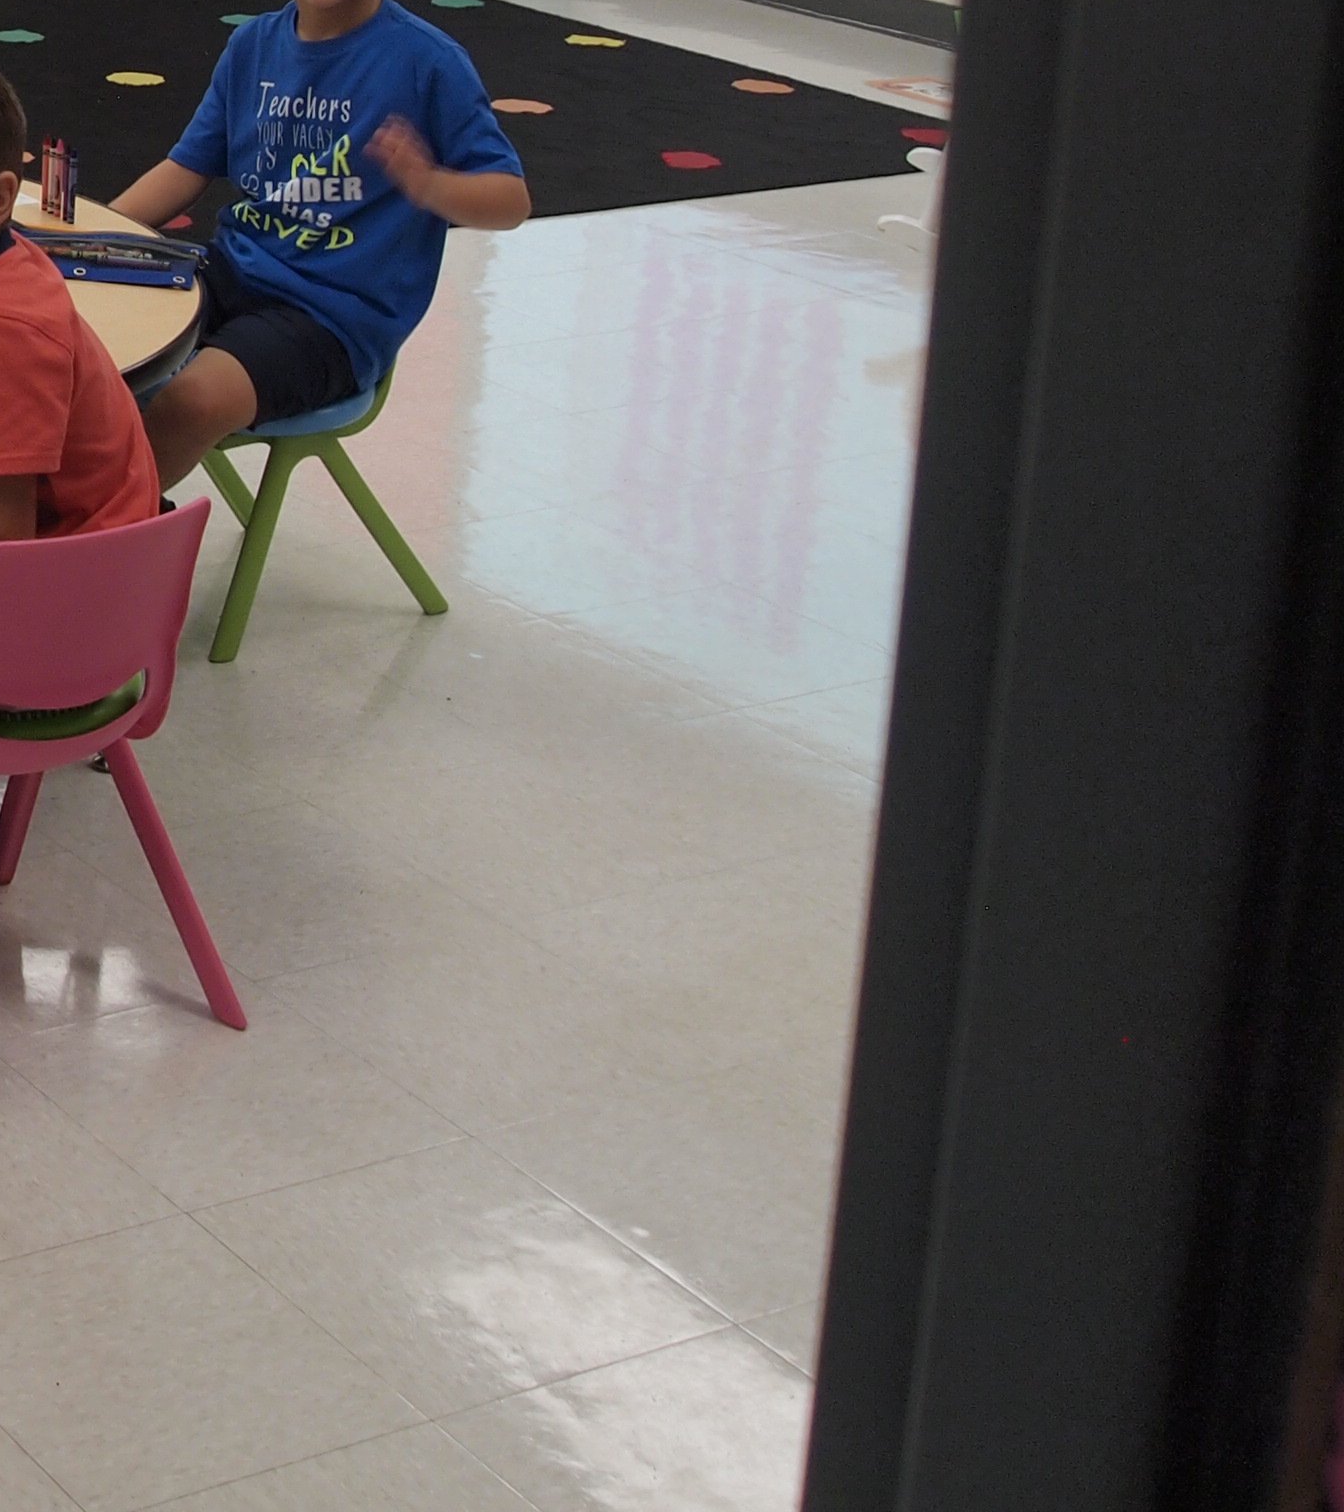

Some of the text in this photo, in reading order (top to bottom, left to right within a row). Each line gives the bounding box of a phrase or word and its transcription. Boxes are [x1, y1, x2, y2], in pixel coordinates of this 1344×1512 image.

[257, 81, 351, 123] Teachers
[257, 121, 333, 152] YOUR VACAY
[282, 202, 332, 228] HAS
